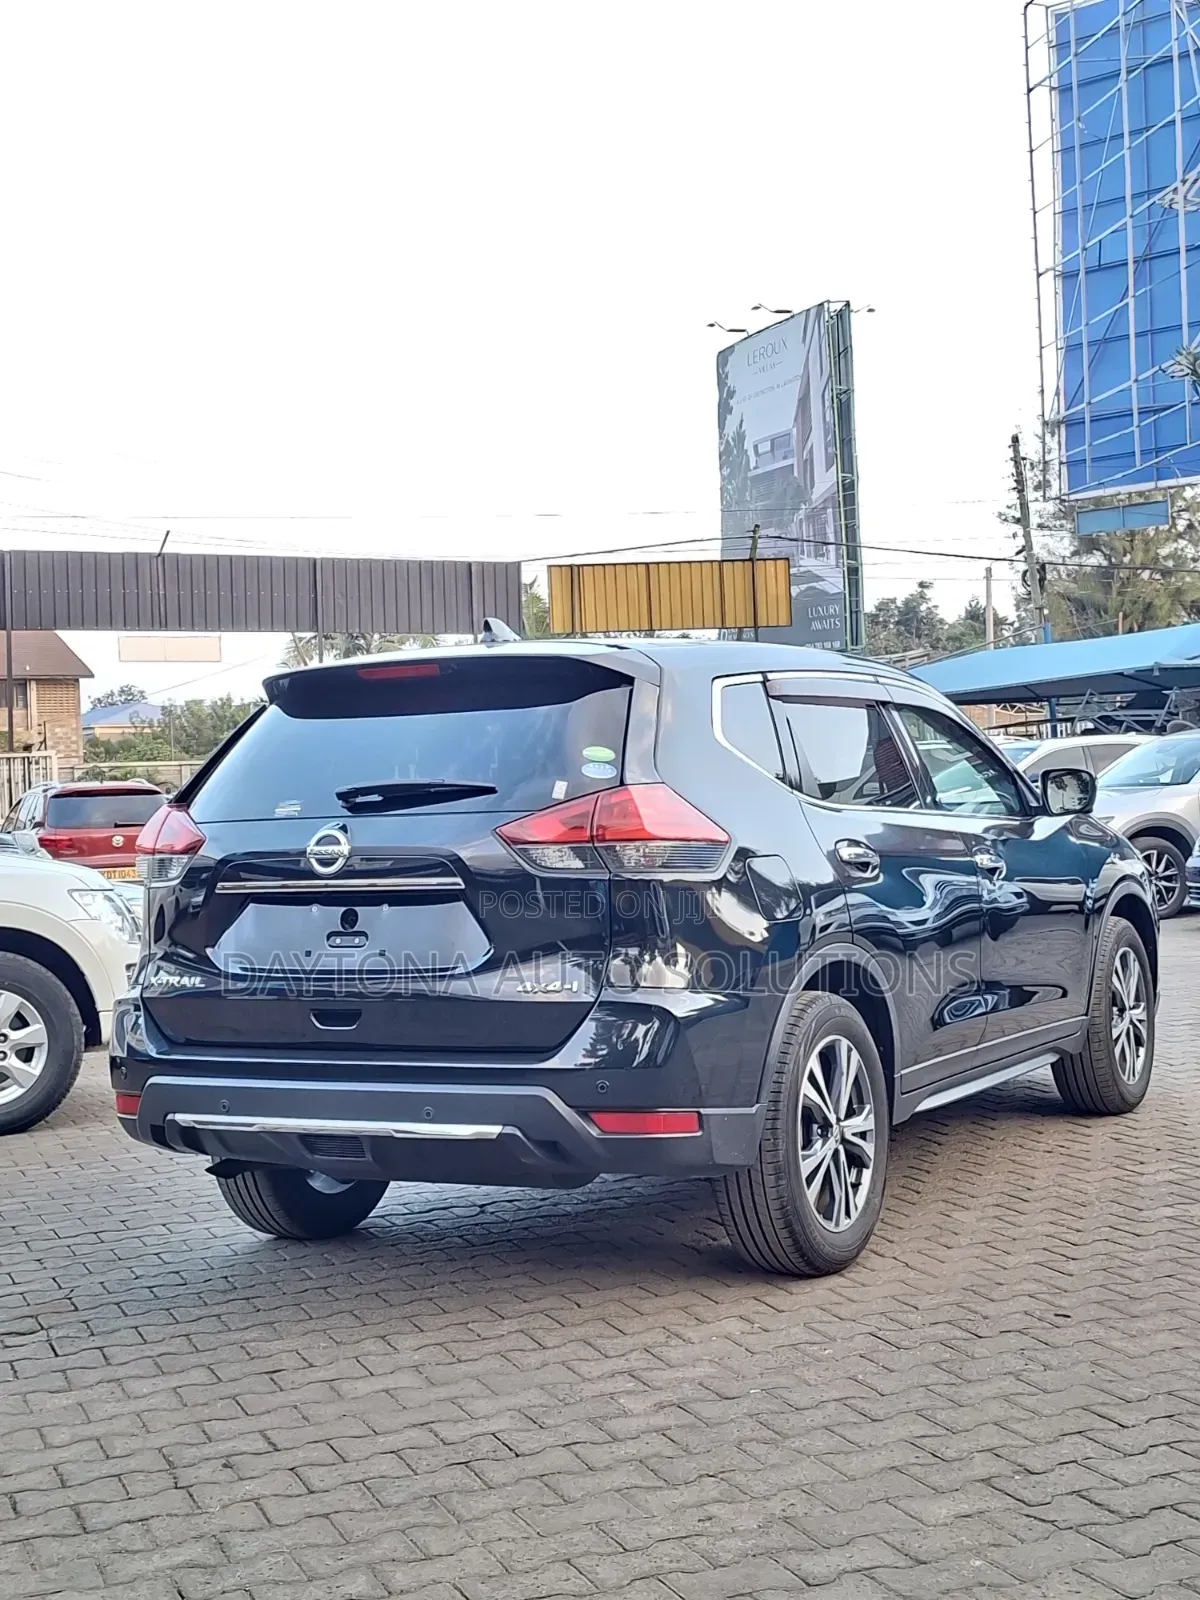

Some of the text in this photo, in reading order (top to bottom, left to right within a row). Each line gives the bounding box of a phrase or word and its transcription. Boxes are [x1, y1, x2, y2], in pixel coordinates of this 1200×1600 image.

[747, 336, 788, 367] LEROUX
[808, 604, 840, 618] LUXURY
[810, 618, 841, 631] AWAITS
[309, 848, 345, 858] NISSAN
[150, 975, 206, 988] X-TRAIL
